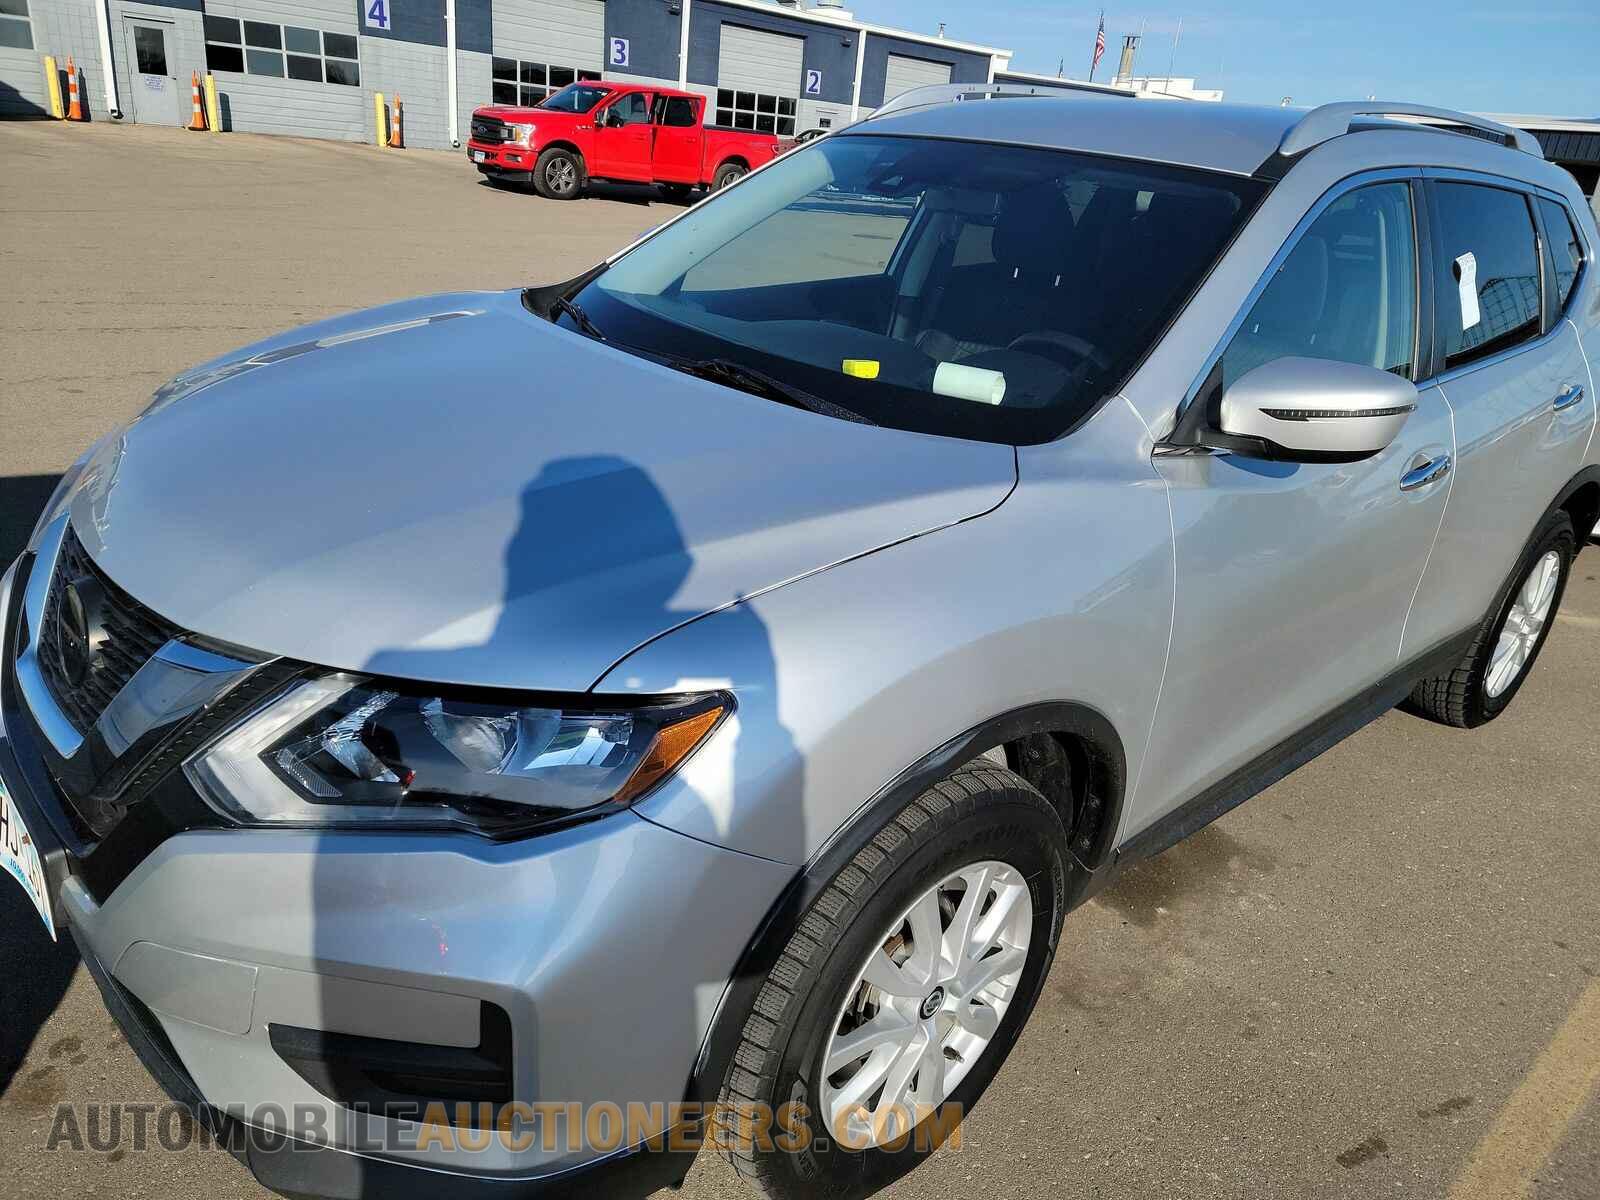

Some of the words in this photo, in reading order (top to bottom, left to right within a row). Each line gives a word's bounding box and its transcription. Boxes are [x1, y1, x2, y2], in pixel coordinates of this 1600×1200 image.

[368, 0, 387, 27] 4
[614, 40, 625, 64] 3
[808, 72, 818, 92] 2
